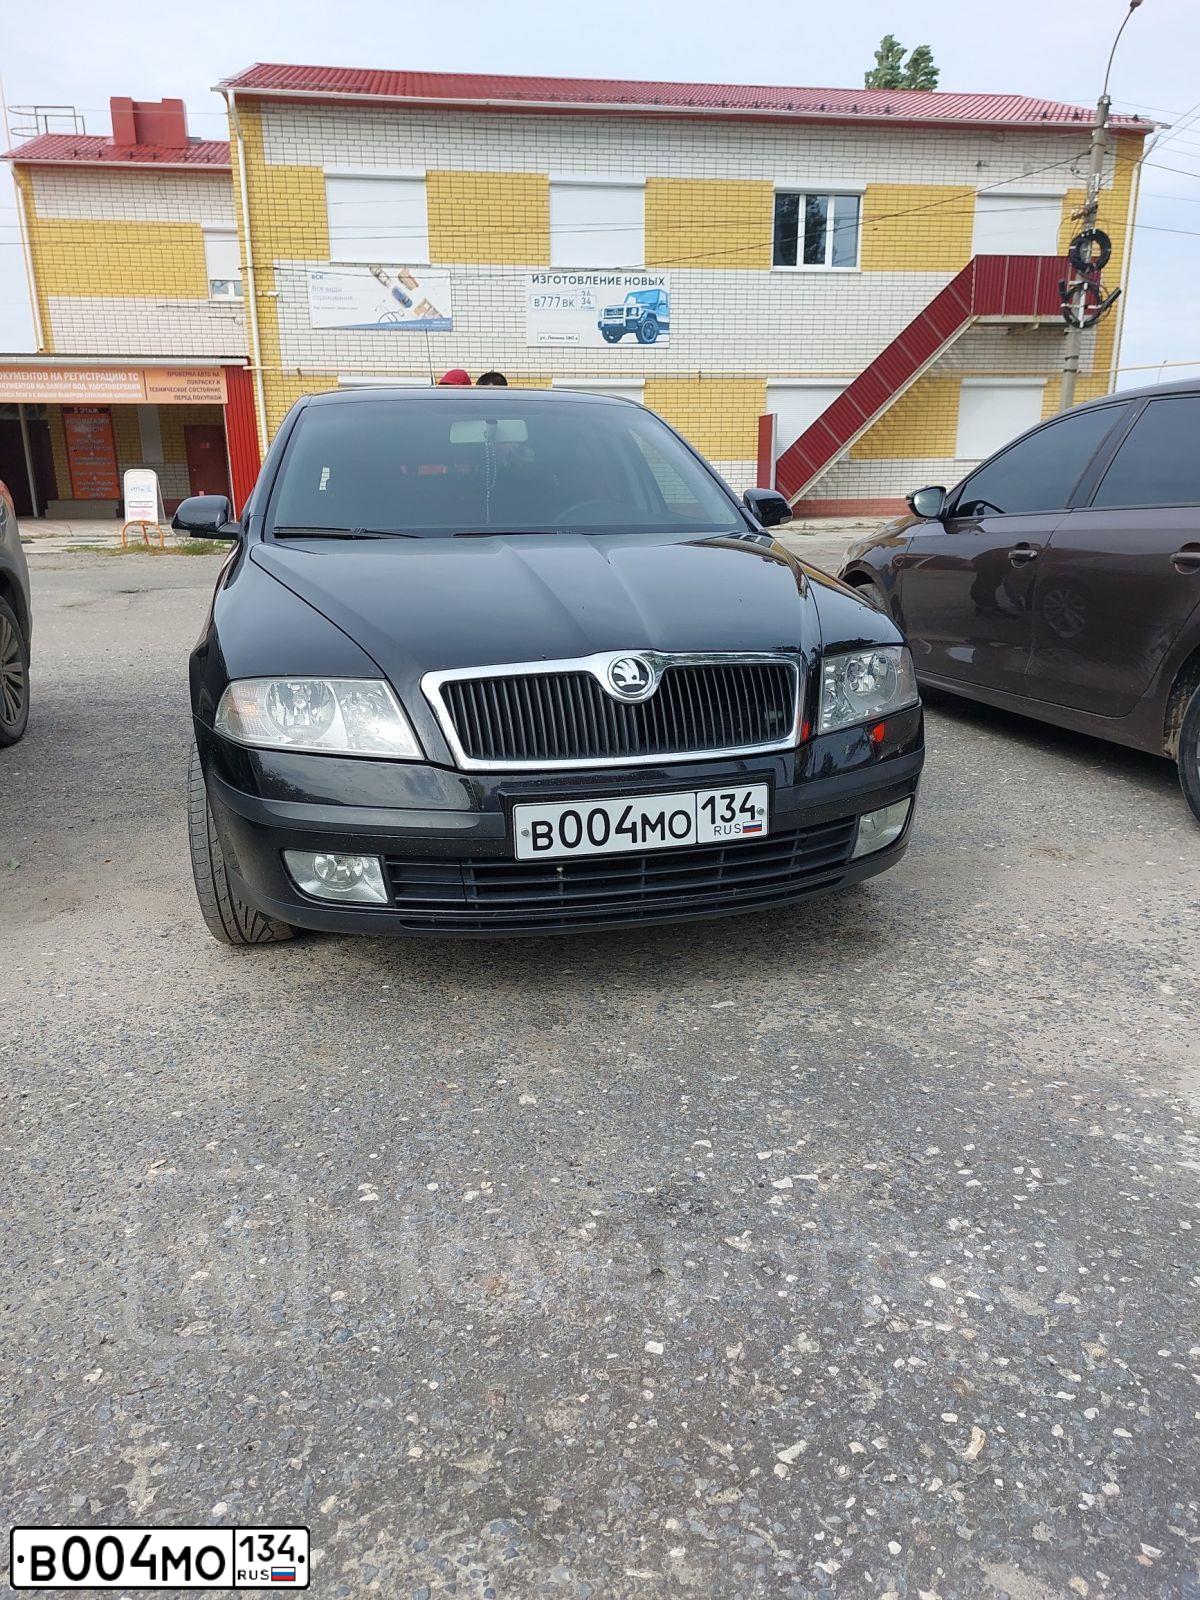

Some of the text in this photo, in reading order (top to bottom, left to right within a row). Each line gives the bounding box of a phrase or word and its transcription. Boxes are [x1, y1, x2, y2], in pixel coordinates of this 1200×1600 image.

[532, 274, 665, 286] ИЗГОТОВЛЕНИЕ НОВЫХ
[534, 296, 576, 309] В777ВК
[64, 372, 127, 382] РЕГИСТРАЦИЮ
[531, 791, 756, 851] В004МО 134
[713, 824, 742, 836] RUS
